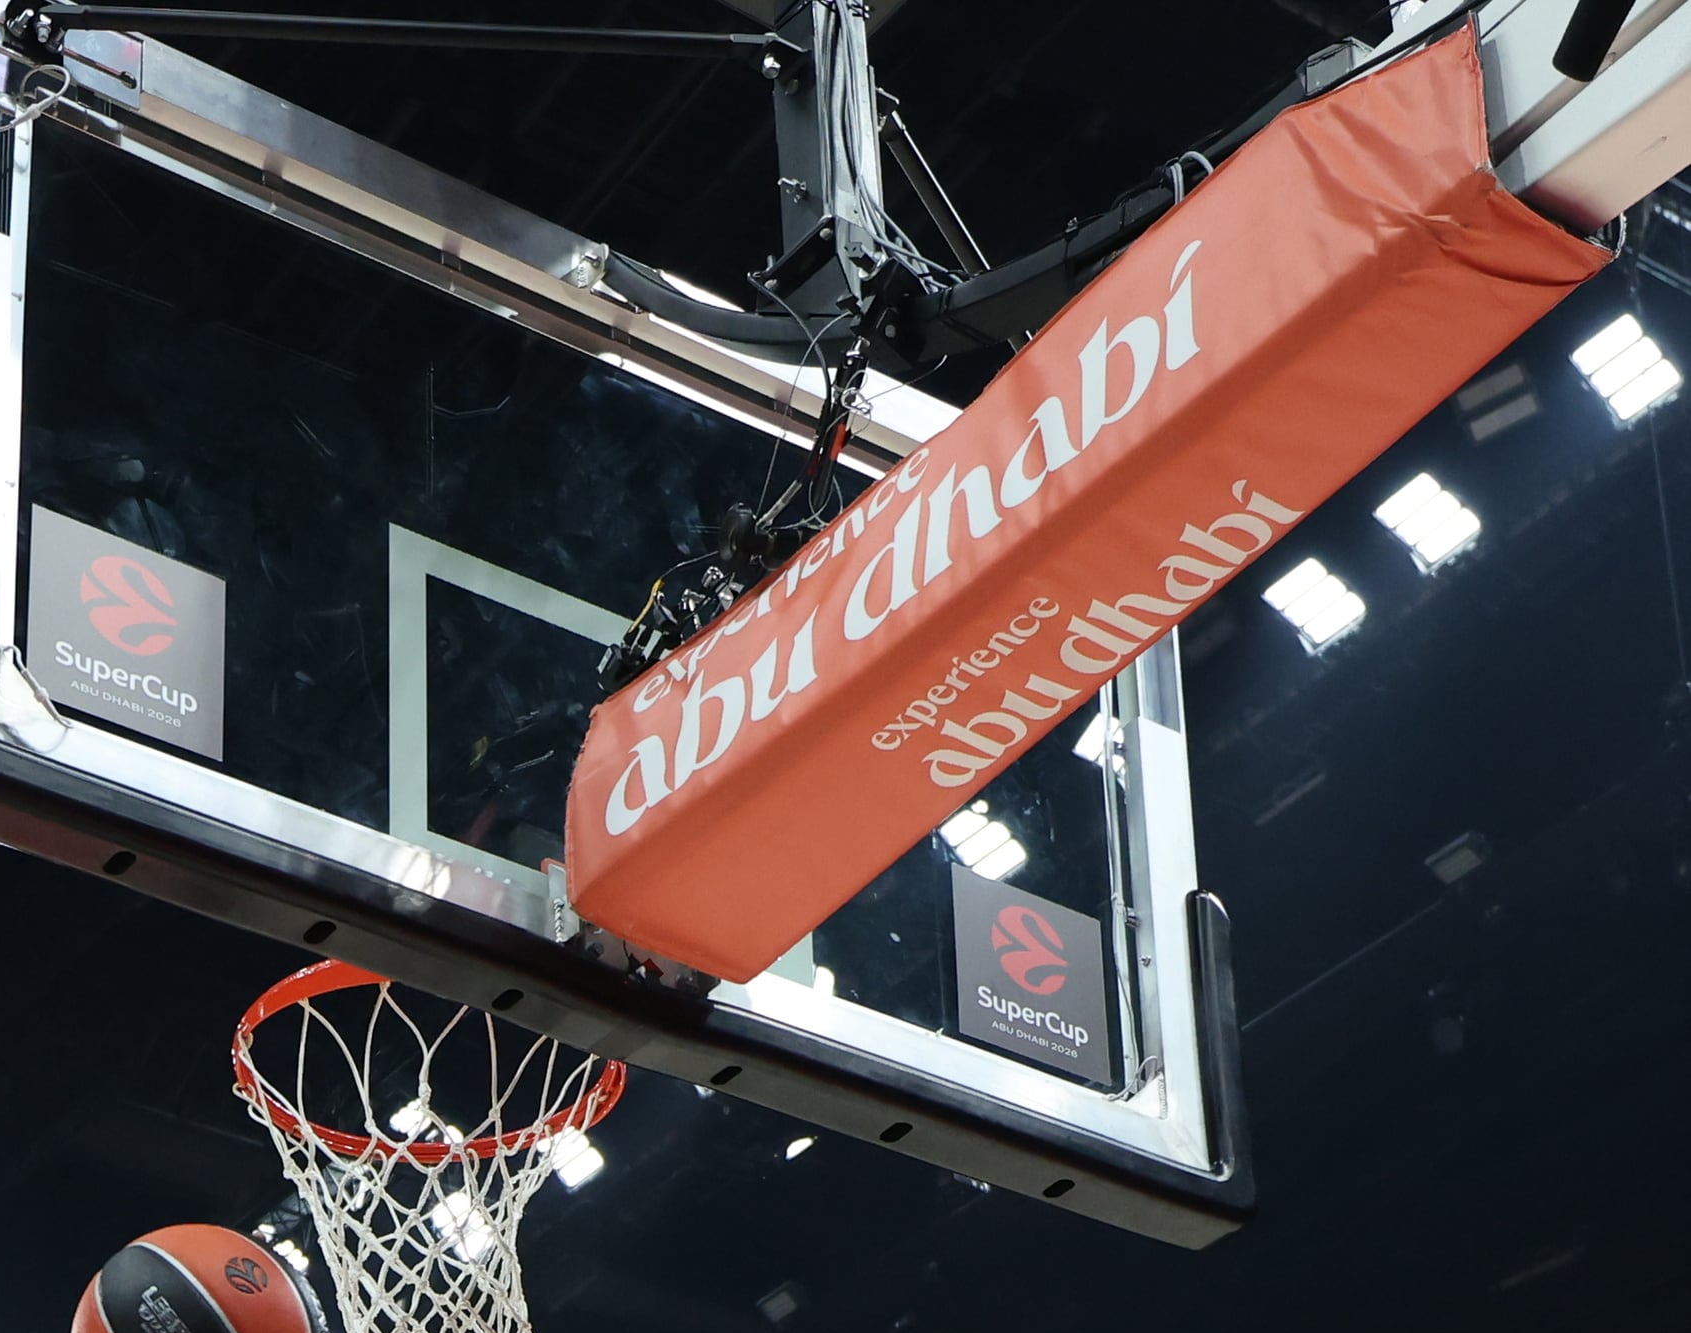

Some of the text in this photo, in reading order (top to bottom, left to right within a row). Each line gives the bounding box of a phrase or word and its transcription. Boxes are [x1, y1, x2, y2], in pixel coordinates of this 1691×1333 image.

[54, 640, 198, 716] SuperCup
[70, 680, 99, 698] ABU
[102, 690, 145, 715] DHABI
[605, 604, 819, 837] abu
[921, 673, 1082, 788] abu
[977, 985, 1089, 1047] SuperCup
[991, 1020, 1014, 1035] ABU
[1016, 1028, 1049, 1048] DHABI
